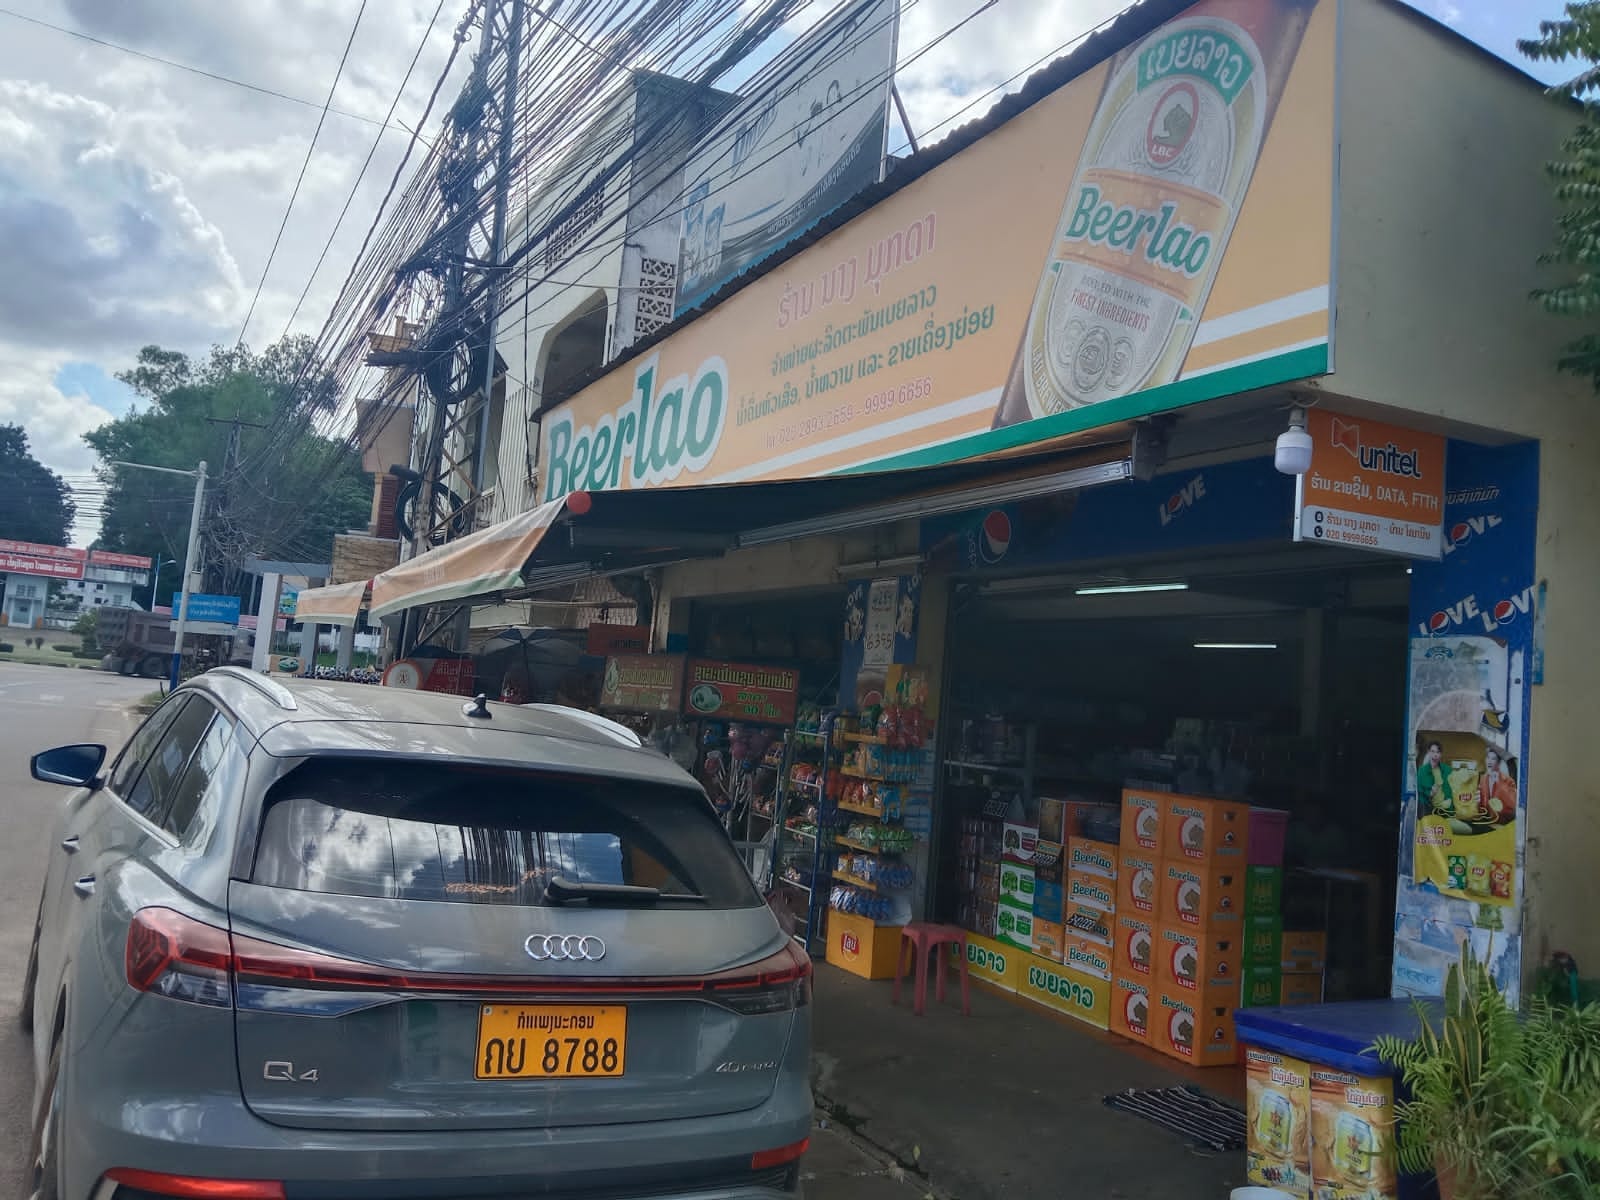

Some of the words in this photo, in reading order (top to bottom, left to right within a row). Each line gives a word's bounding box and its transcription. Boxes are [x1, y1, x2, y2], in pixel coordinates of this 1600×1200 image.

[1146, 35, 1243, 89] ເບຍລາວ
[1066, 186, 1211, 274] Beerlao
[822, 255, 858, 306] ນາງ
[864, 211, 938, 296] ມຸກດາ
[857, 351, 884, 378] ແລະ
[864, 388, 897, 415] 9999
[898, 376, 933, 404] 6656
[546, 366, 723, 500] Beerlao
[1359, 444, 1422, 479] unitel
[1376, 486, 1409, 508] DATA,
[1412, 492, 1438, 510] FTTH
[1326, 529, 1341, 539] 020
[1074, 849, 1112, 869] Beerlao
[1168, 867, 1200, 882] Beerlao
[1072, 881, 1111, 902] Beerlao
[1069, 947, 1108, 971] Beerlao
[1029, 966, 1096, 1010] ເບຍລາວ
[1161, 995, 1193, 1014] Beerlao
[542, 1038, 618, 1073] 8788
